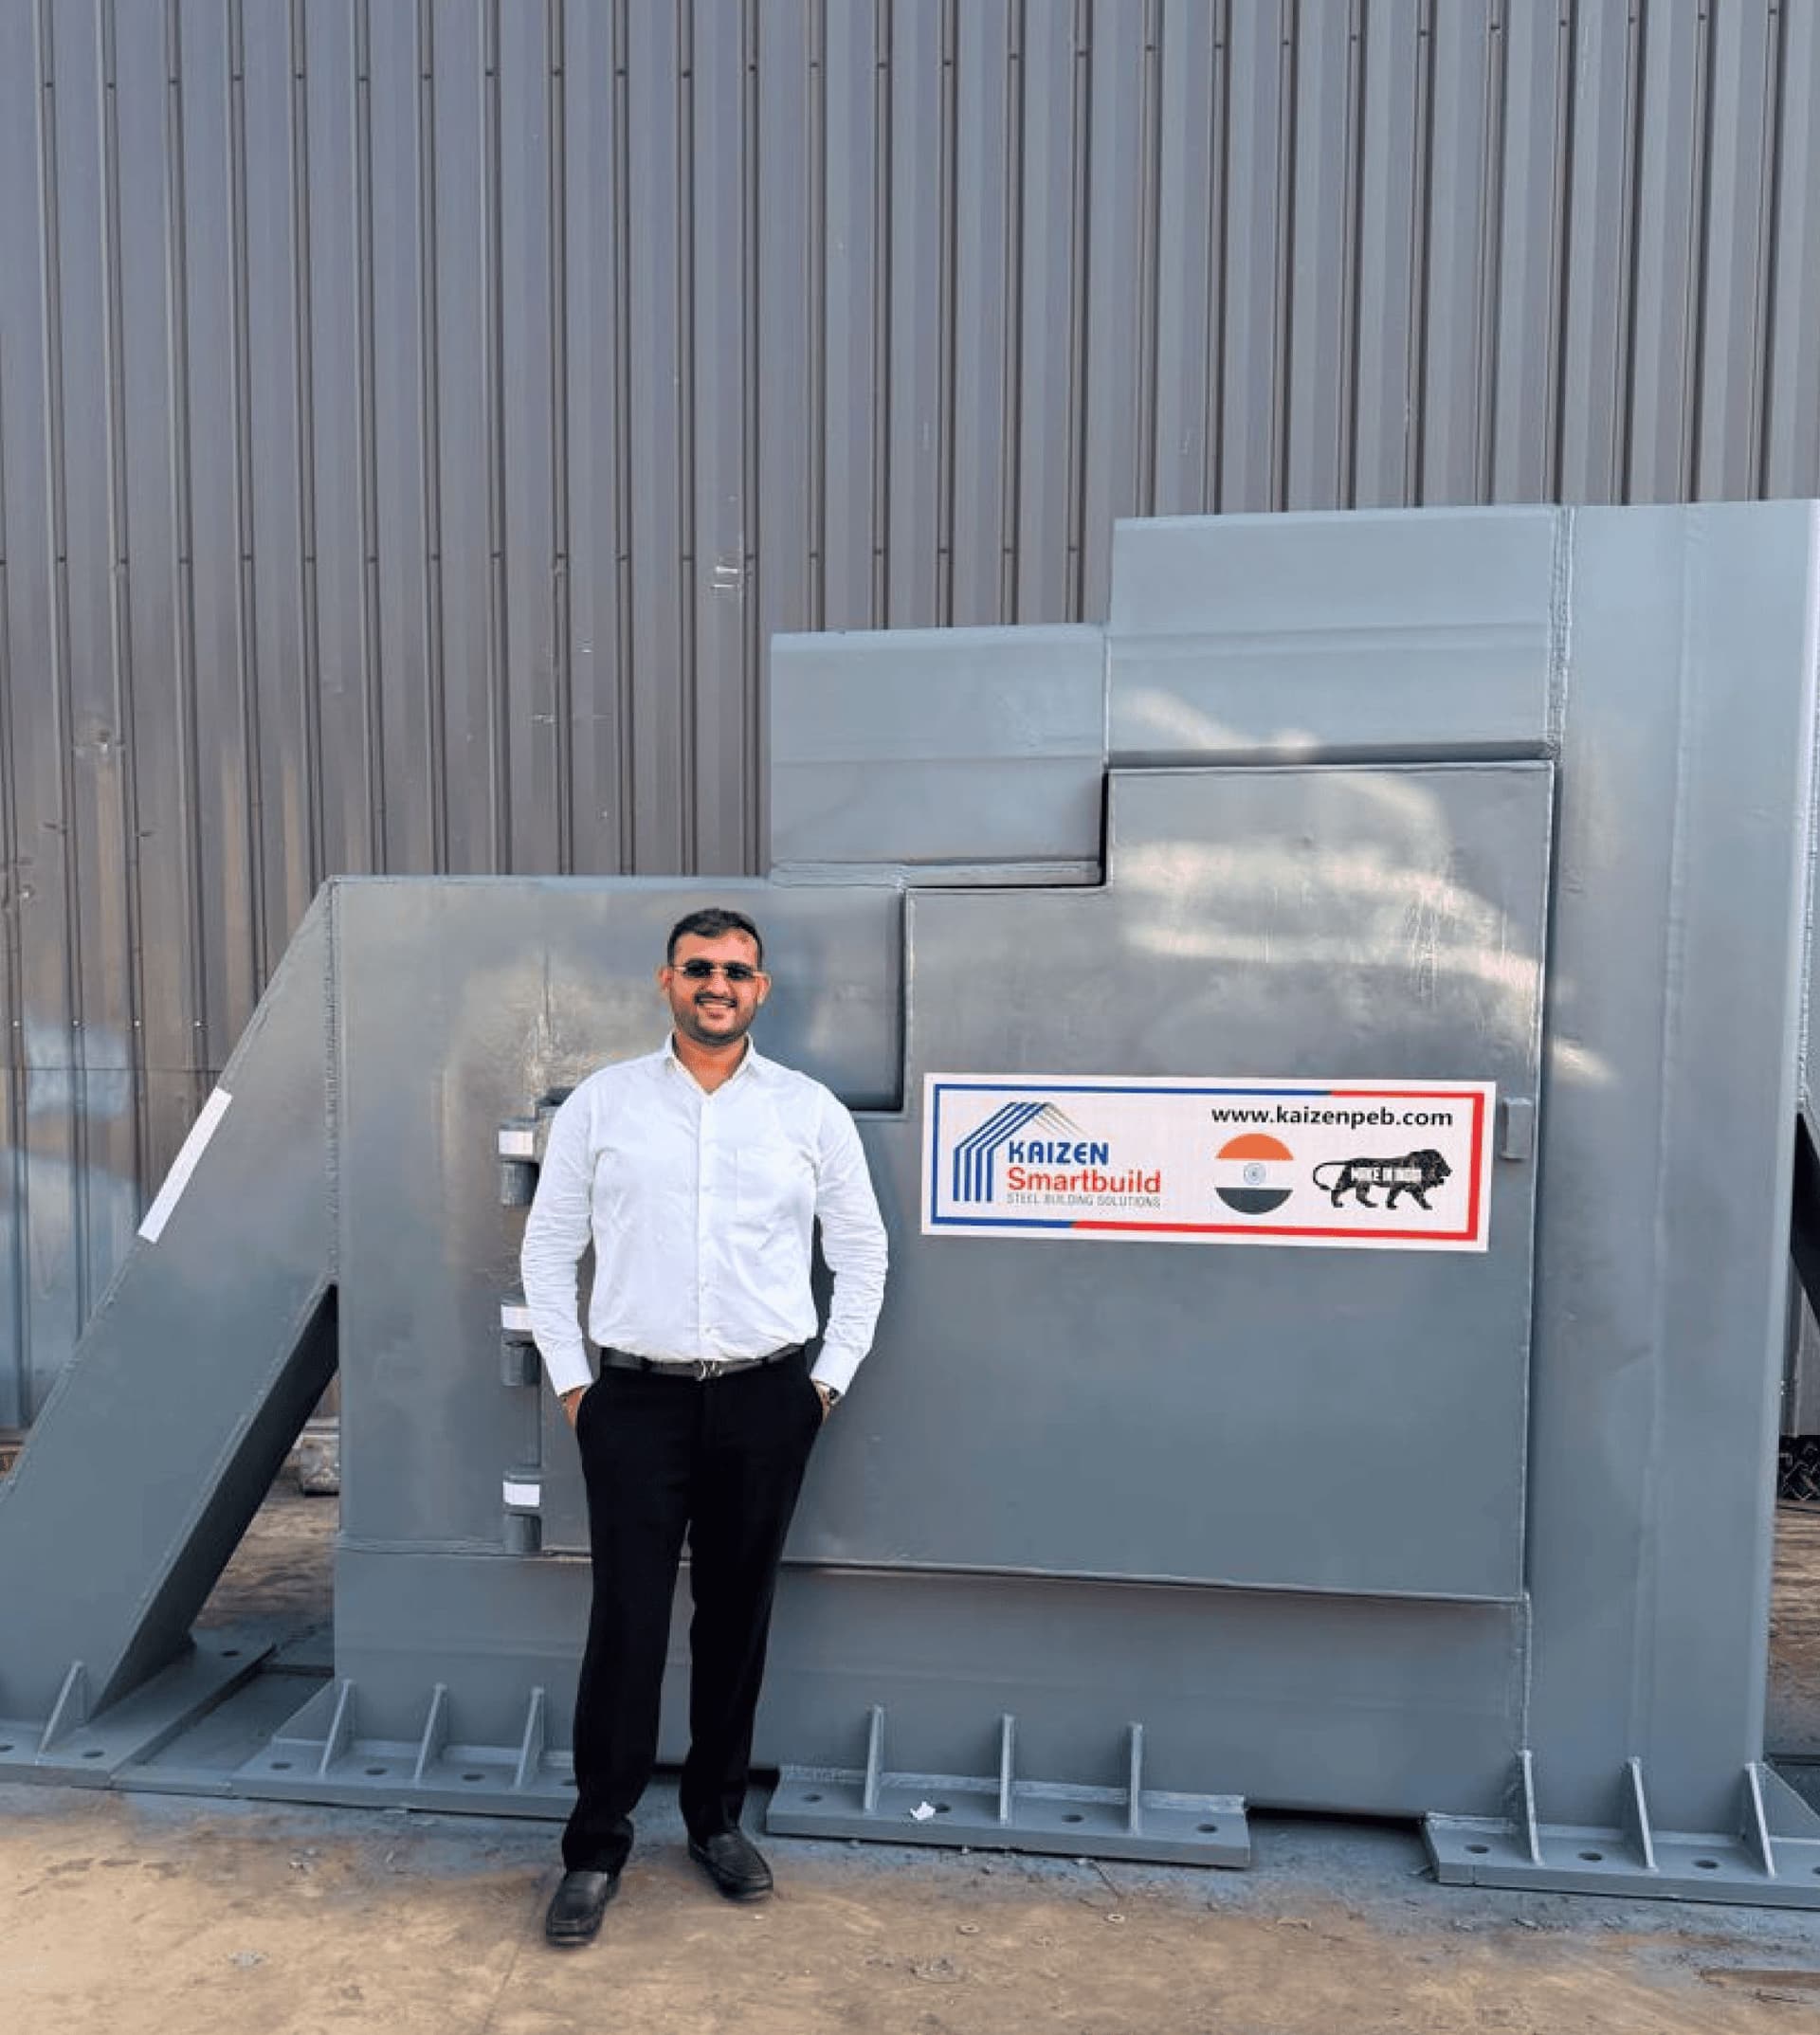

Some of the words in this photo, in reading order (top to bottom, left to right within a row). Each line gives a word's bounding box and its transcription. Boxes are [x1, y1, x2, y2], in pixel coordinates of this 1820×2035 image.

[1211, 1105, 1453, 1130] www.kaizenpeb.com
[1009, 1140, 1109, 1165] KAIZEN
[1007, 1167, 1161, 1193] Smartbuild
[1007, 1192, 1038, 1205] STEEL
[1044, 1193, 1093, 1207] BUILDING
[1097, 1195, 1161, 1208] SOLUTIONS
